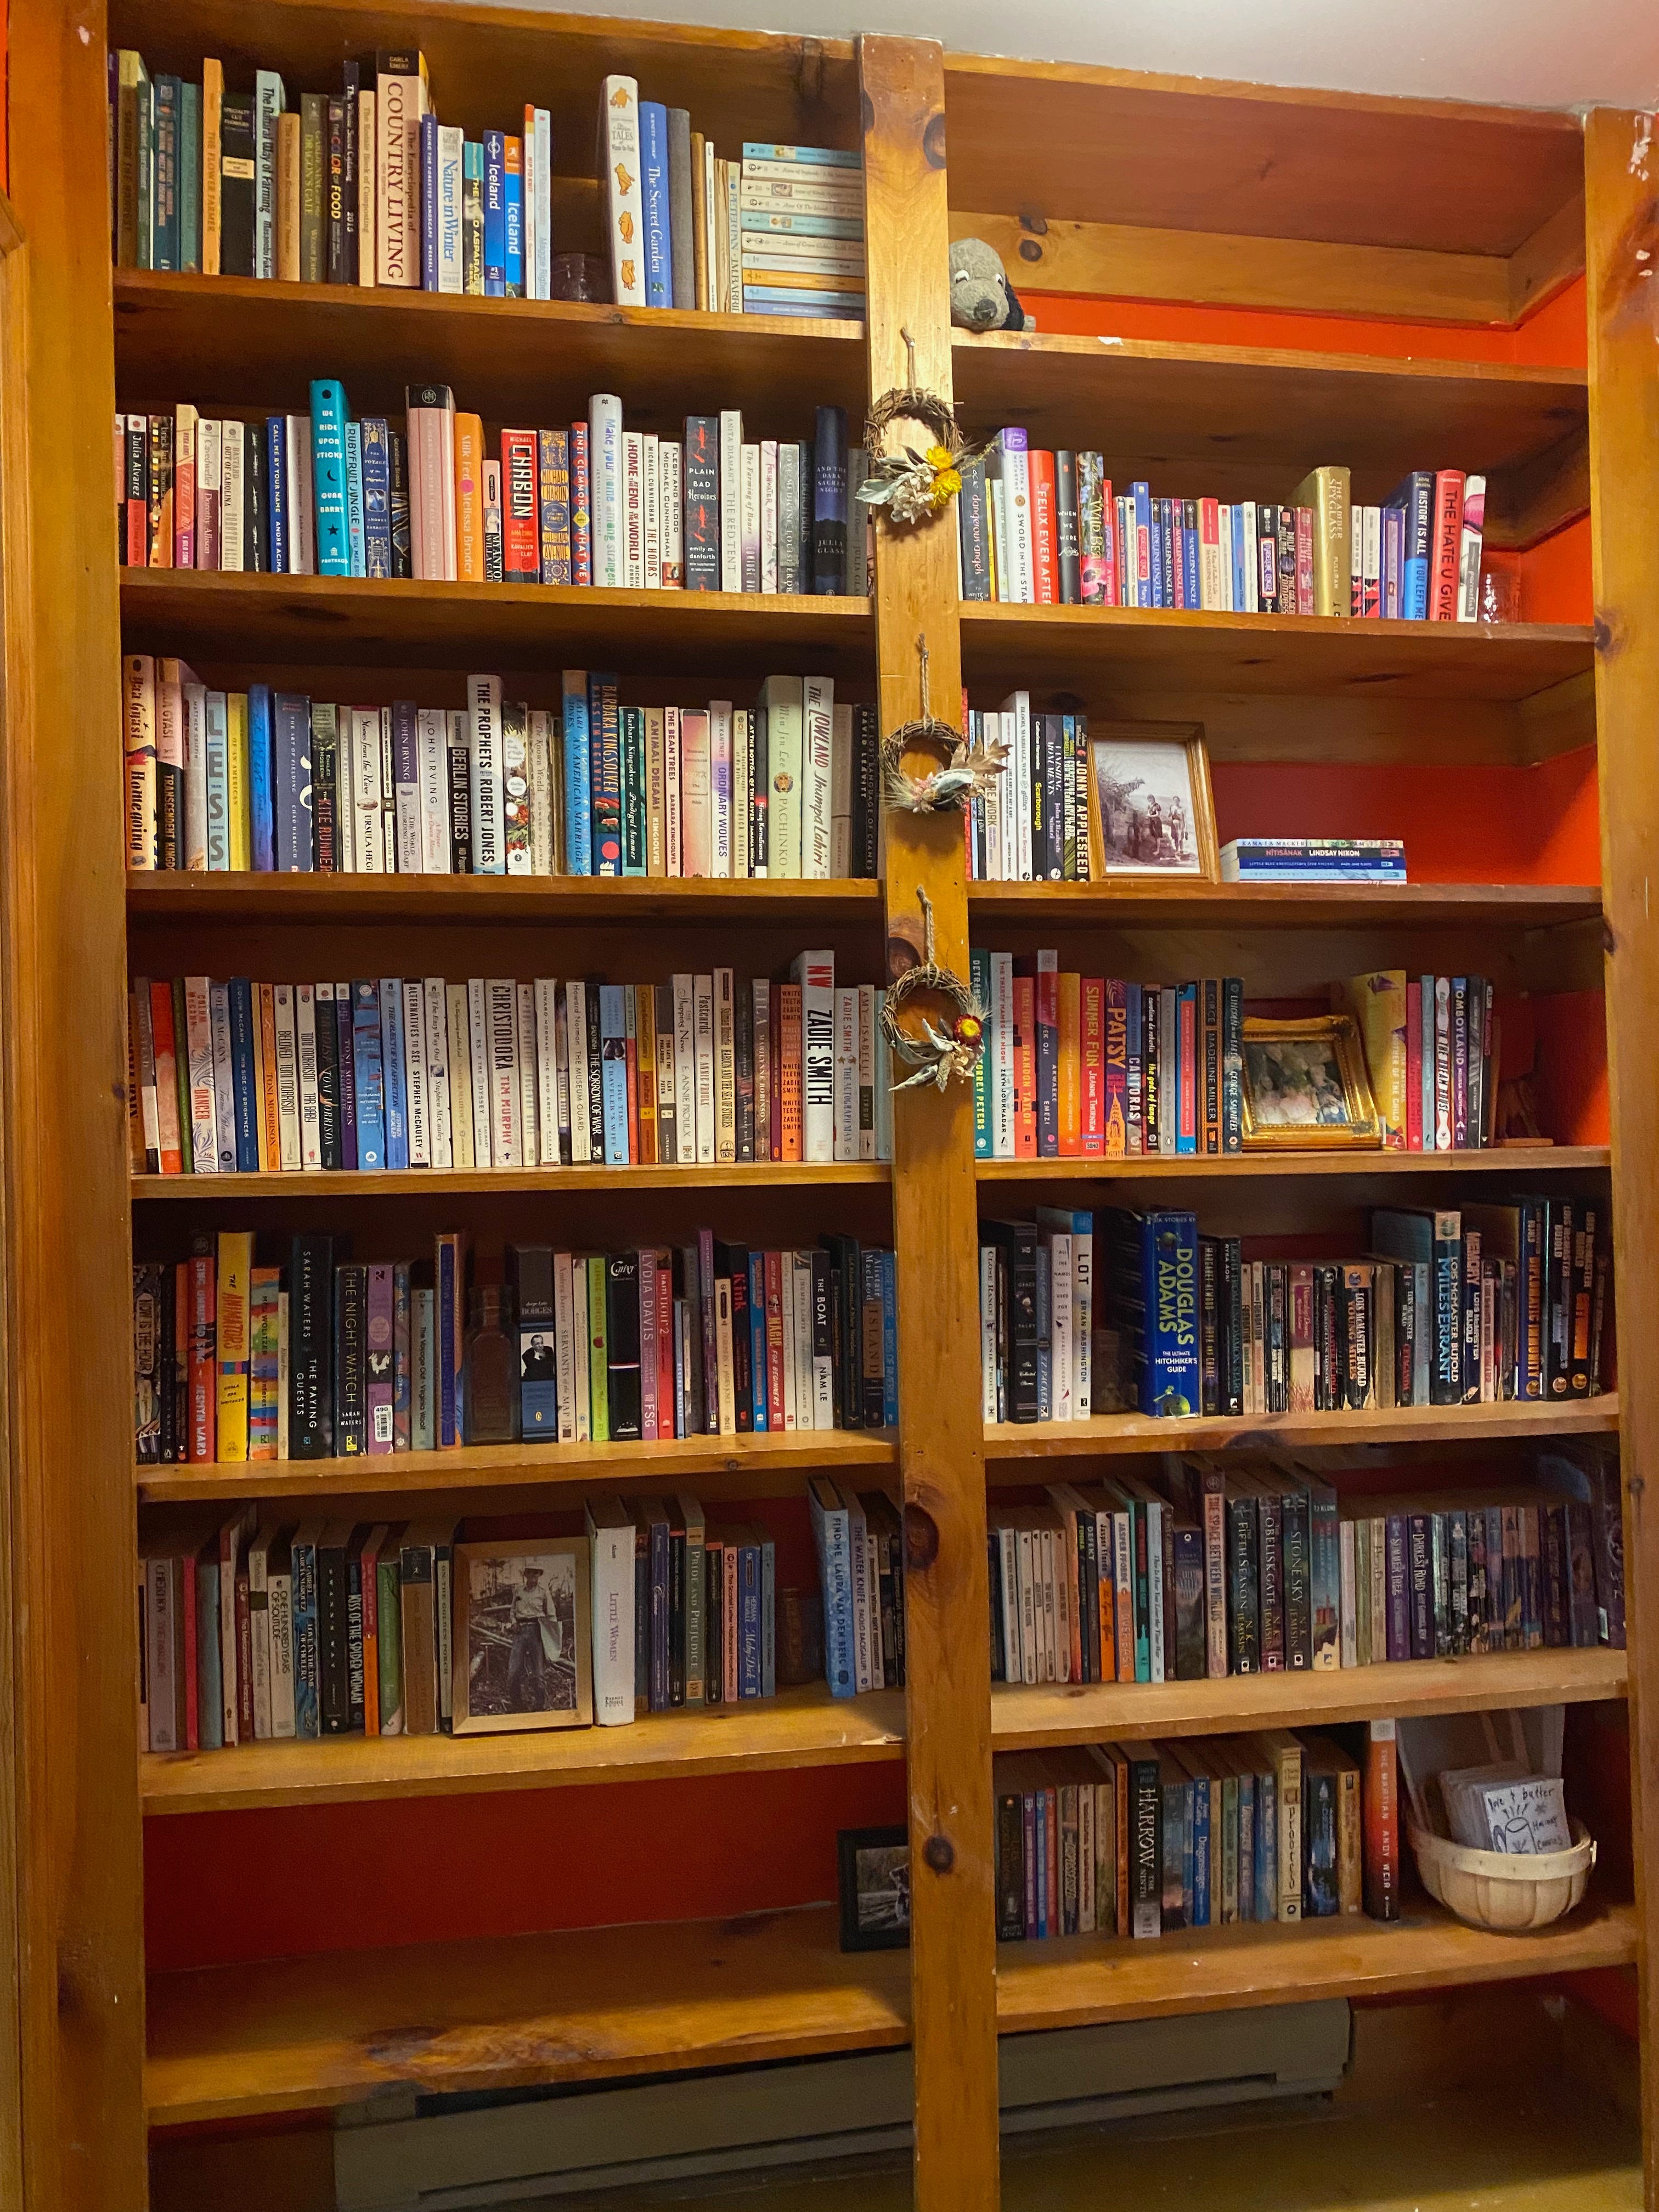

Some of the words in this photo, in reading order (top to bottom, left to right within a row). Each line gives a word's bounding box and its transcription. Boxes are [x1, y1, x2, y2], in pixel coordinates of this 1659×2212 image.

[263, 88, 274, 104] The
[262, 107, 274, 139] Natural
[388, 82, 403, 193] COUNTRY
[261, 142, 273, 162] Way
[262, 164, 274, 173] of
[259, 176, 273, 213] Farming
[405, 153, 416, 219] Encyclopedia
[443, 159, 458, 202] Nature
[489, 164, 500, 210] Iceland
[648, 166, 661, 188] The
[331, 185, 341, 218] FOOD
[444, 205, 458, 216] in
[650, 190, 662, 227] Secret
[388, 197, 403, 278] LIVING
[408, 222, 416, 232] of
[444, 218, 458, 262] Winter
[508, 202, 520, 255] Iceland
[651, 229, 663, 273] Garden
[133, 435, 141, 458] Julia
[605, 419, 616, 445] Make
[203, 440, 212, 487] Cavedweller
[274, 446, 279, 456] ME
[274, 458, 280, 467] BY
[348, 428, 357, 484] RUBYFRUIT
[603, 450, 616, 472] your
[133, 461, 142, 496] Alvarez
[511, 445, 533, 517] CHABON
[606, 475, 616, 501] home
[202, 493, 212, 524] Dorothy
[349, 487, 359, 524] JUNGLE
[726, 492, 735, 514] THE
[969, 494, 981, 541] dangerous
[1037, 491, 1048, 524] FELIX
[1418, 490, 1427, 525] HISTORY
[1444, 490, 1458, 518] THE
[204, 527, 212, 554] Allison
[603, 506, 616, 541] among
[647, 529, 657, 544] THE
[727, 518, 735, 538] RED
[1418, 528, 1427, 536] IS
[727, 539, 736, 573] TENT
[971, 545, 984, 574] angels
[1041, 531, 1049, 563] EVER
[1417, 539, 1427, 555] ALL
[1442, 524, 1456, 563] HATE
[605, 544, 617, 586] strangers
[647, 548, 657, 578] HOURS
[1417, 565, 1425, 581] YOU
[1441, 569, 1453, 579] U
[1416, 584, 1425, 603] LEFT
[1439, 585, 1453, 620] GIVE
[1415, 607, 1424, 619] ME
[477, 684, 489, 703] THE
[477, 708, 492, 768] PROPHETS
[573, 737, 579, 751] AN
[429, 760, 437, 804] IRVING
[452, 748, 467, 789] BERLIN
[1076, 760, 1087, 798] JONNY
[479, 779, 493, 822] ROBERT
[718, 767, 727, 815] ORDINARY
[1034, 782, 1042, 831] Scarborough
[130, 770, 148, 850] Homegoing
[318, 799, 332, 823] KITE
[454, 793, 468, 840] STORIES
[319, 827, 332, 871] RUNNER
[364, 815, 373, 847] URSULA
[480, 827, 495, 866] JONES,
[574, 811, 583, 862] MARRIAGE
[719, 819, 727, 857] WOLVES
[778, 798, 788, 866] PACHINKO
[1076, 805, 1088, 873] APPLESEED
[807, 966, 832, 989] NW
[492, 986, 514, 1070] CHRISTODORA
[1086, 986, 1099, 1036] SUMMER
[1455, 984, 1465, 1065] TOMBOYLAND
[278, 1031, 292, 1058] BELOVED
[807, 1010, 832, 1051] ZADIE
[1107, 1007, 1126, 1069] PATSY
[280, 1064, 294, 1077] TONI
[1087, 1042, 1099, 1067] FUN
[1207, 1034, 1216, 1083] MADELINE
[281, 1080, 295, 1115] MORRISON
[500, 1076, 509, 1096] TIM
[808, 1057, 832, 1104] SMITH
[1128, 1057, 1141, 1119] CANTORAS
[500, 1099, 512, 1144] MURPHY
[345, 1272, 357, 1295] THE
[642, 1255, 653, 1293] LYDIA
[1078, 1254, 1089, 1285] LOT
[1438, 1258, 1449, 1310] MILES
[817, 1296, 827, 1325] BOAT
[1158, 1260, 1177, 1333] ADAMS
[1176, 1248, 1194, 1345] DOUGLAS
[303, 1293, 311, 1338] WATERS
[345, 1302, 357, 1347] NIGHT
[643, 1301, 653, 1340] DAVIS
[1437, 1313, 1451, 1383] ERRANT
[296, 1373, 304, 1415] GUESTS
[346, 1353, 357, 1402] WATCH
[820, 1392, 827, 1401] LE
[1265, 1517, 1275, 1571] OBELISK
[690, 1551, 701, 1583] PRIDE
[691, 1588, 699, 1606] AND
[1265, 1573, 1275, 1605] GATE
[610, 1593, 619, 1623] LITTLE
[609, 1626, 619, 1662] WOMEN
[690, 1610, 701, 1668] PREJUDICE
[1138, 1788, 1159, 1869] HARROW
